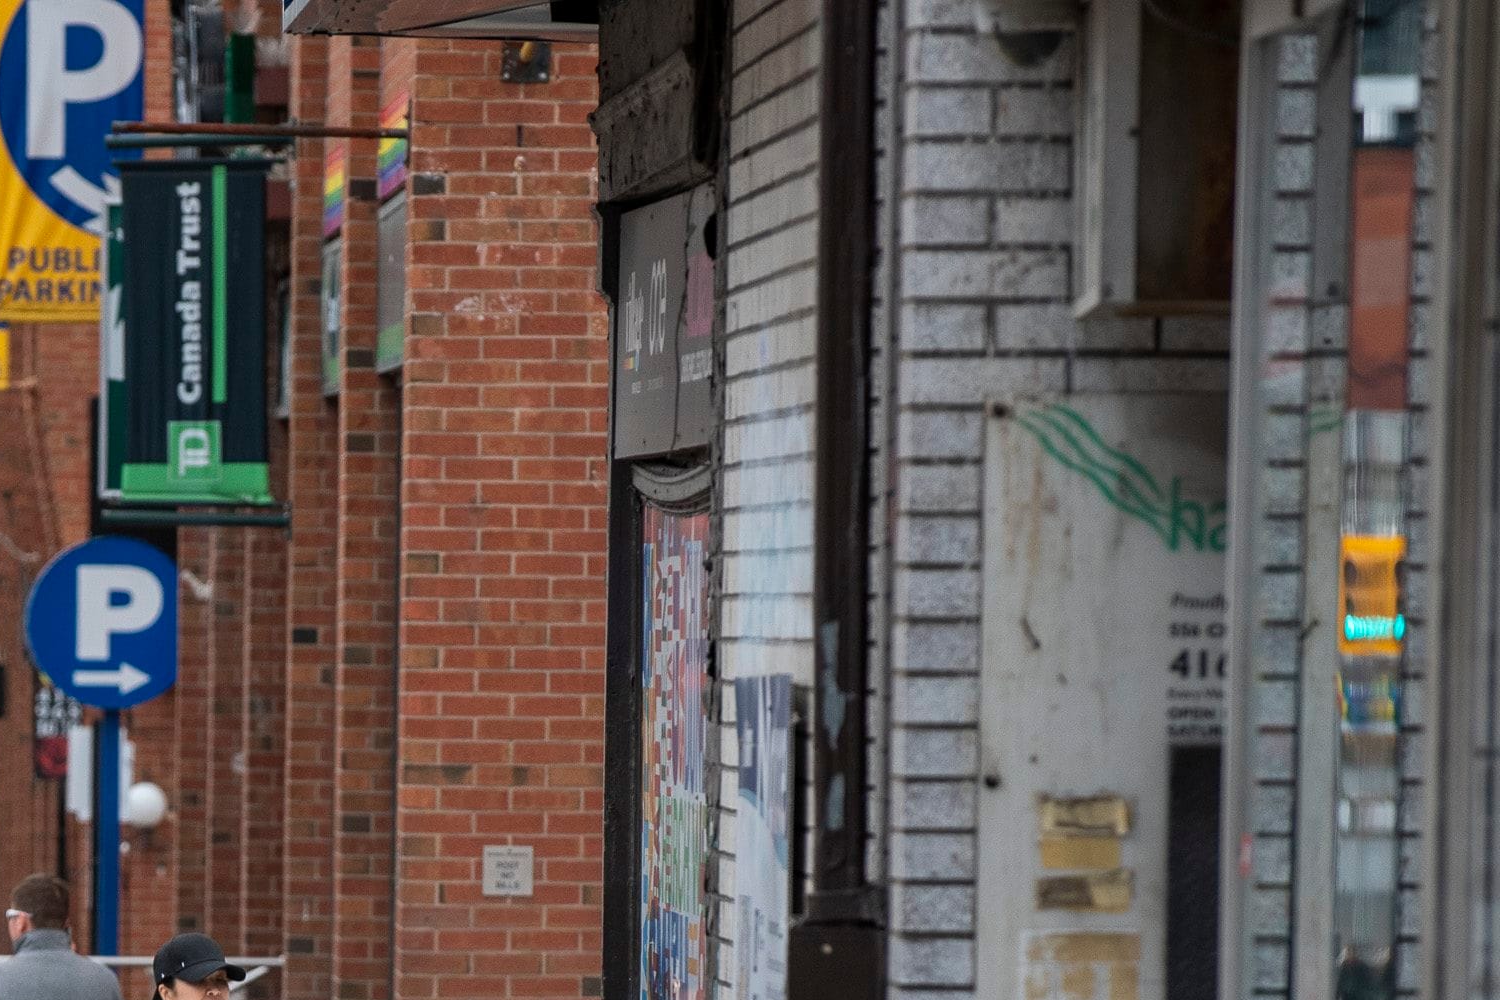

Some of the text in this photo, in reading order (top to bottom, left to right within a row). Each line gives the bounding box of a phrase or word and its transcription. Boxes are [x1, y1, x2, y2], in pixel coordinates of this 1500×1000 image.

[7, 248, 100, 270] PUBLI
[176, 181, 210, 477] TD Canada Trust
[75, 563, 165, 661] P
